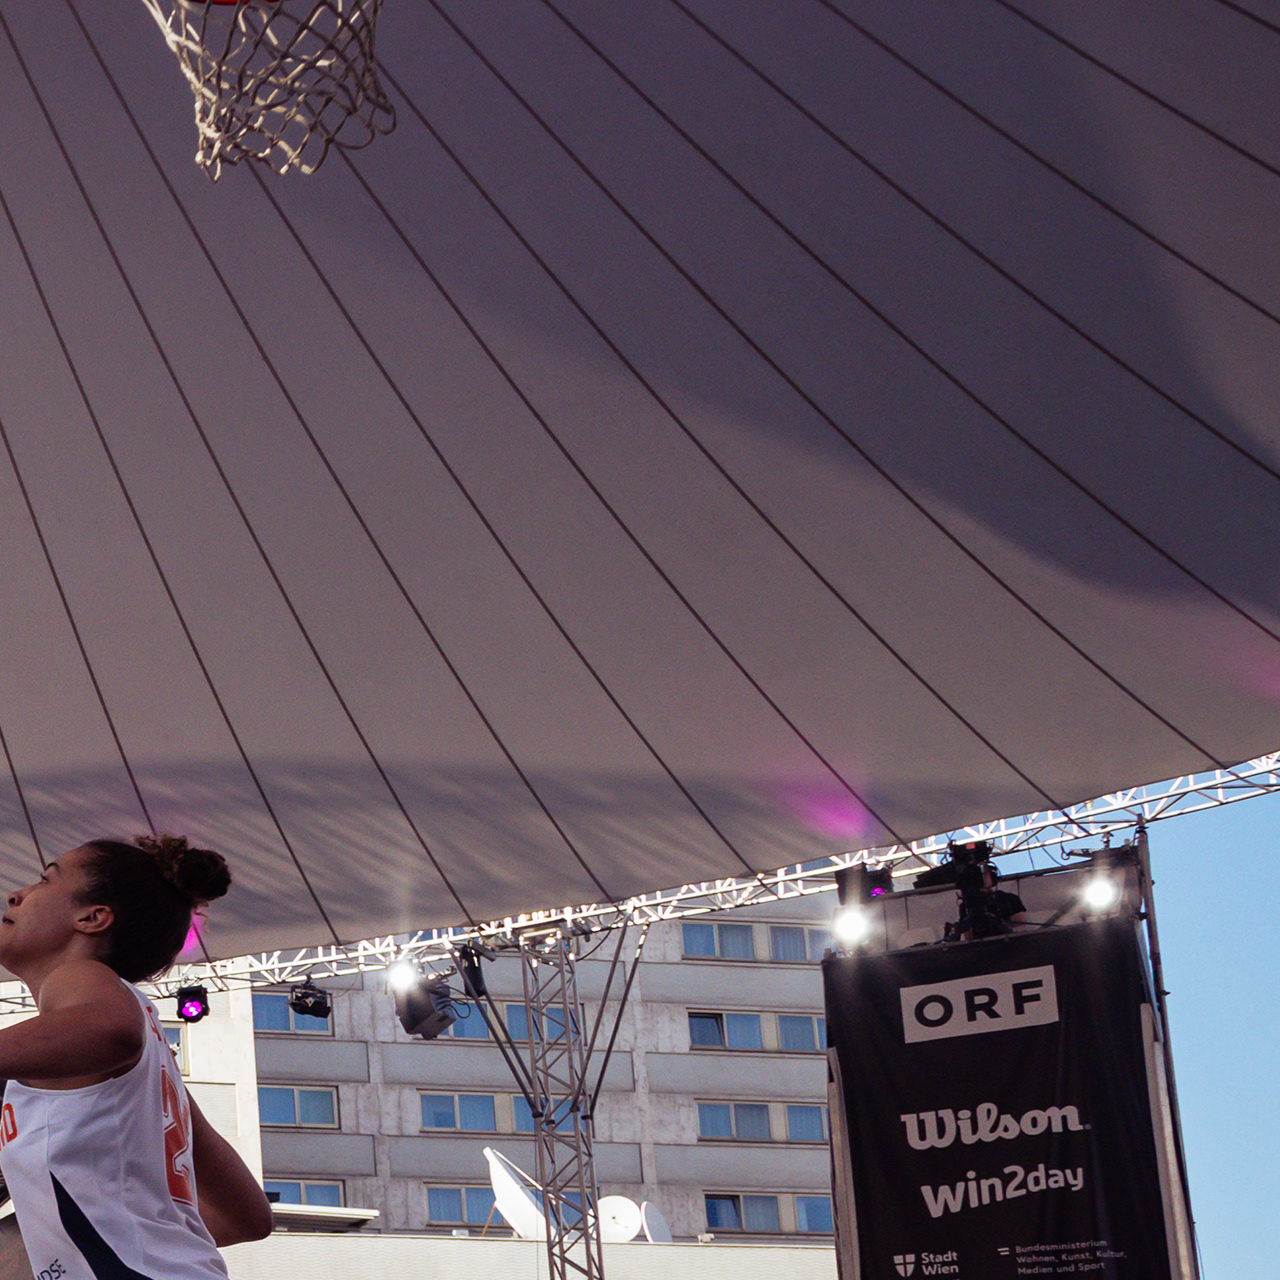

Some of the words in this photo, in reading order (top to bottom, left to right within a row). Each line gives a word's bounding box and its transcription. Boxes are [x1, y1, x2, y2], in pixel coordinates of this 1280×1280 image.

[914, 979, 1044, 1028] ORF
[901, 1102, 1087, 1150] Wilson
[921, 1163, 1084, 1218] win2day
[1015, 1240, 1107, 1253] Bundesministerium
[921, 1251, 958, 1264] Stadt
[1016, 1254, 1059, 1265] Wohnen,
[922, 1264, 959, 1277] Wien
[1018, 1265, 1053, 1276] Medien
[1057, 1264, 1075, 1274] und
[1078, 1262, 1105, 1274] Sport
